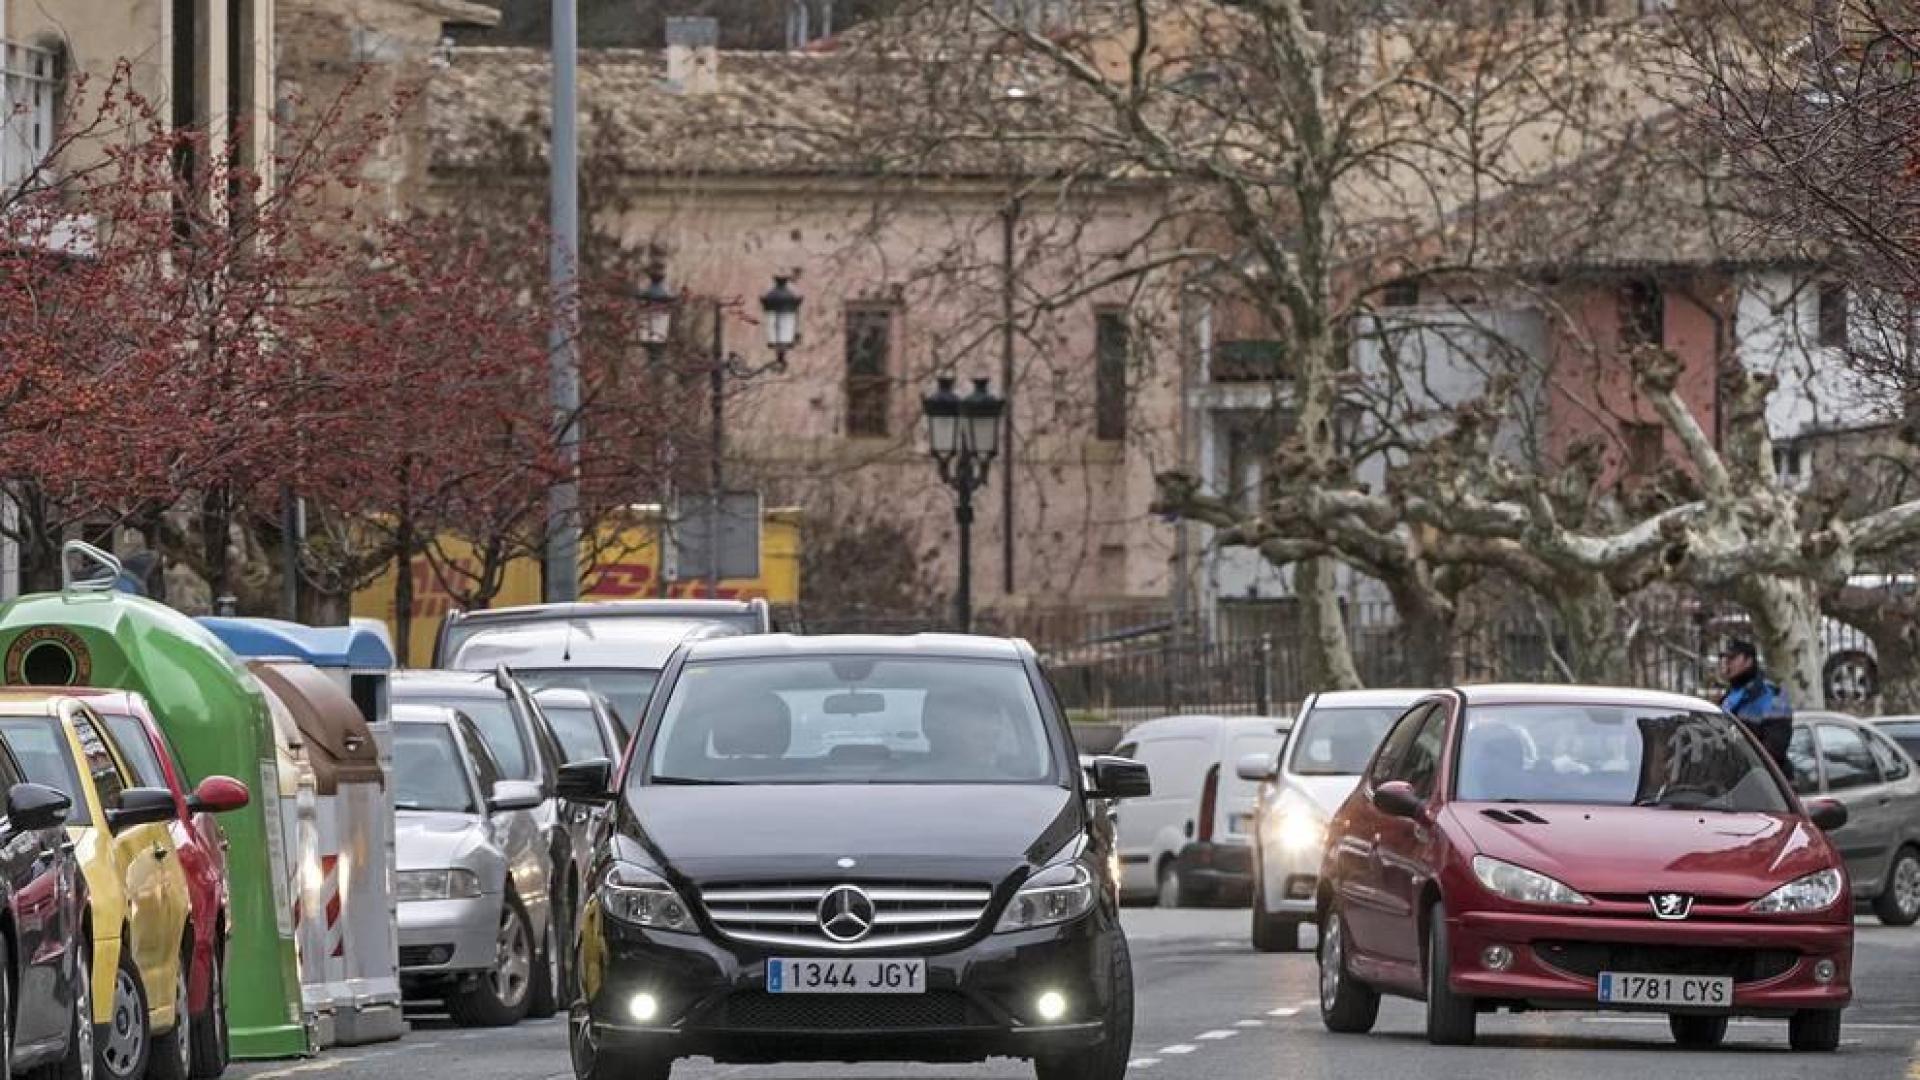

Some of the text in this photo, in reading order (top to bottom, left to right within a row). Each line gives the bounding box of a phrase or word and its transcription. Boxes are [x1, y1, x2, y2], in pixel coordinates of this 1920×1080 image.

[791, 962, 919, 988] 1344 JGY
[1621, 976, 1724, 1002] 1781 CYS
